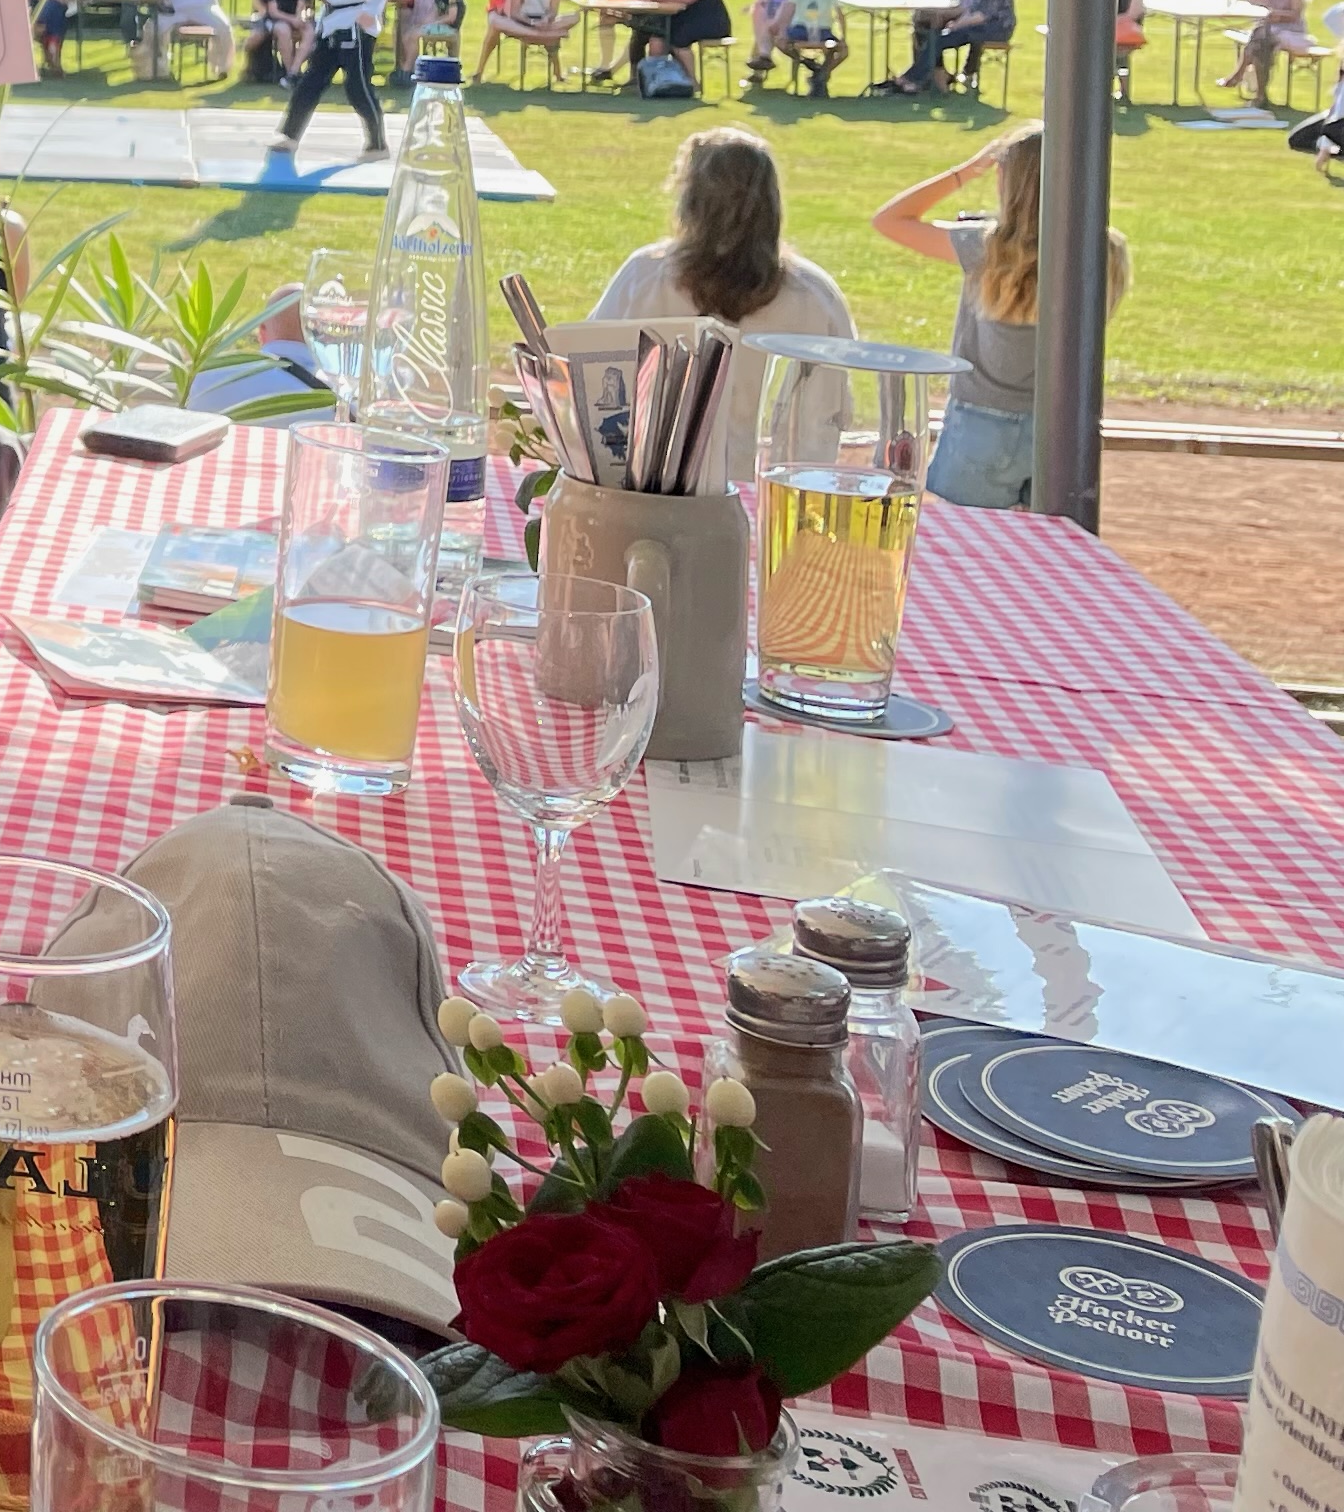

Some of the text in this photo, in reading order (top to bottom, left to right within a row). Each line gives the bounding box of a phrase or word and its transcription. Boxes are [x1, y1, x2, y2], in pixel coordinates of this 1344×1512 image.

[391, 271, 454, 426] Classic
[1047, 1305, 1175, 1349] Pschorr
[1054, 1293, 1177, 1334] Hacker
